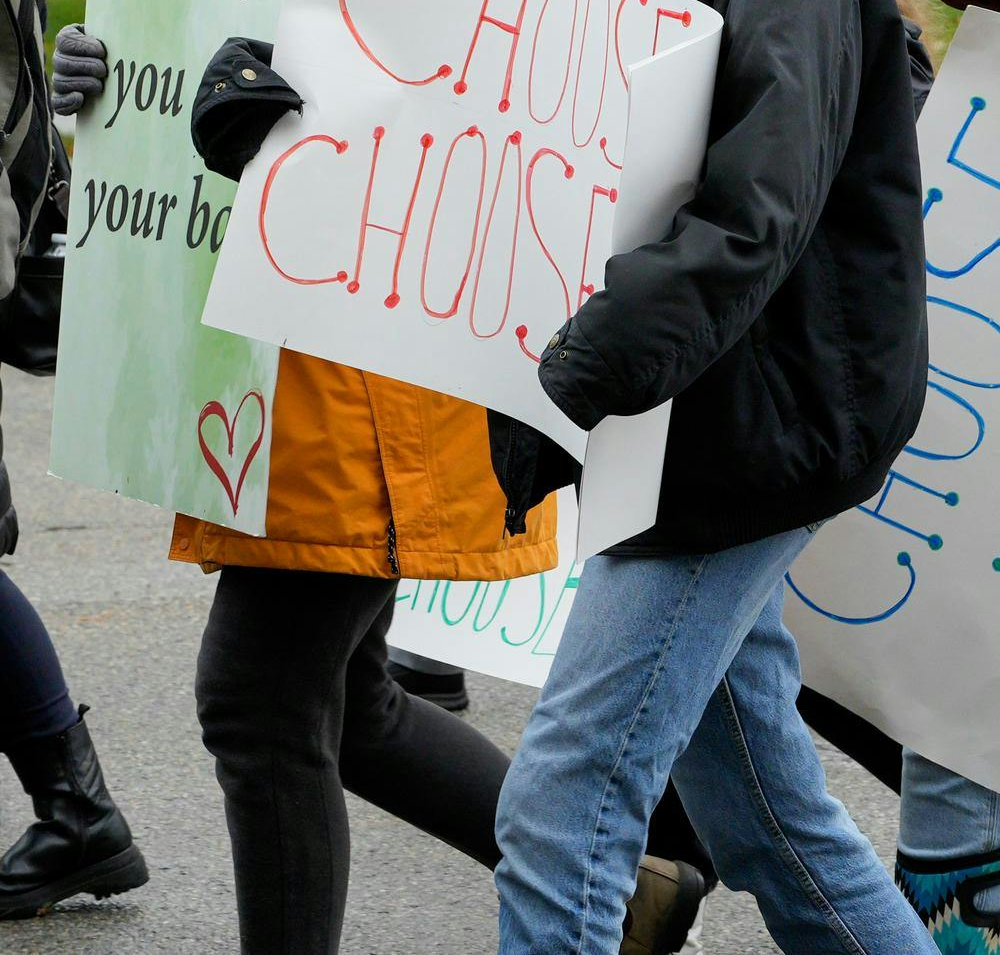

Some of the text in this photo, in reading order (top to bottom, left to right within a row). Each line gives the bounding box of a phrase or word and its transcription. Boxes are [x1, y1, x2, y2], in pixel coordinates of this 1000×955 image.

[104, 58, 186, 129] you
[75, 174, 232, 253] your bo
